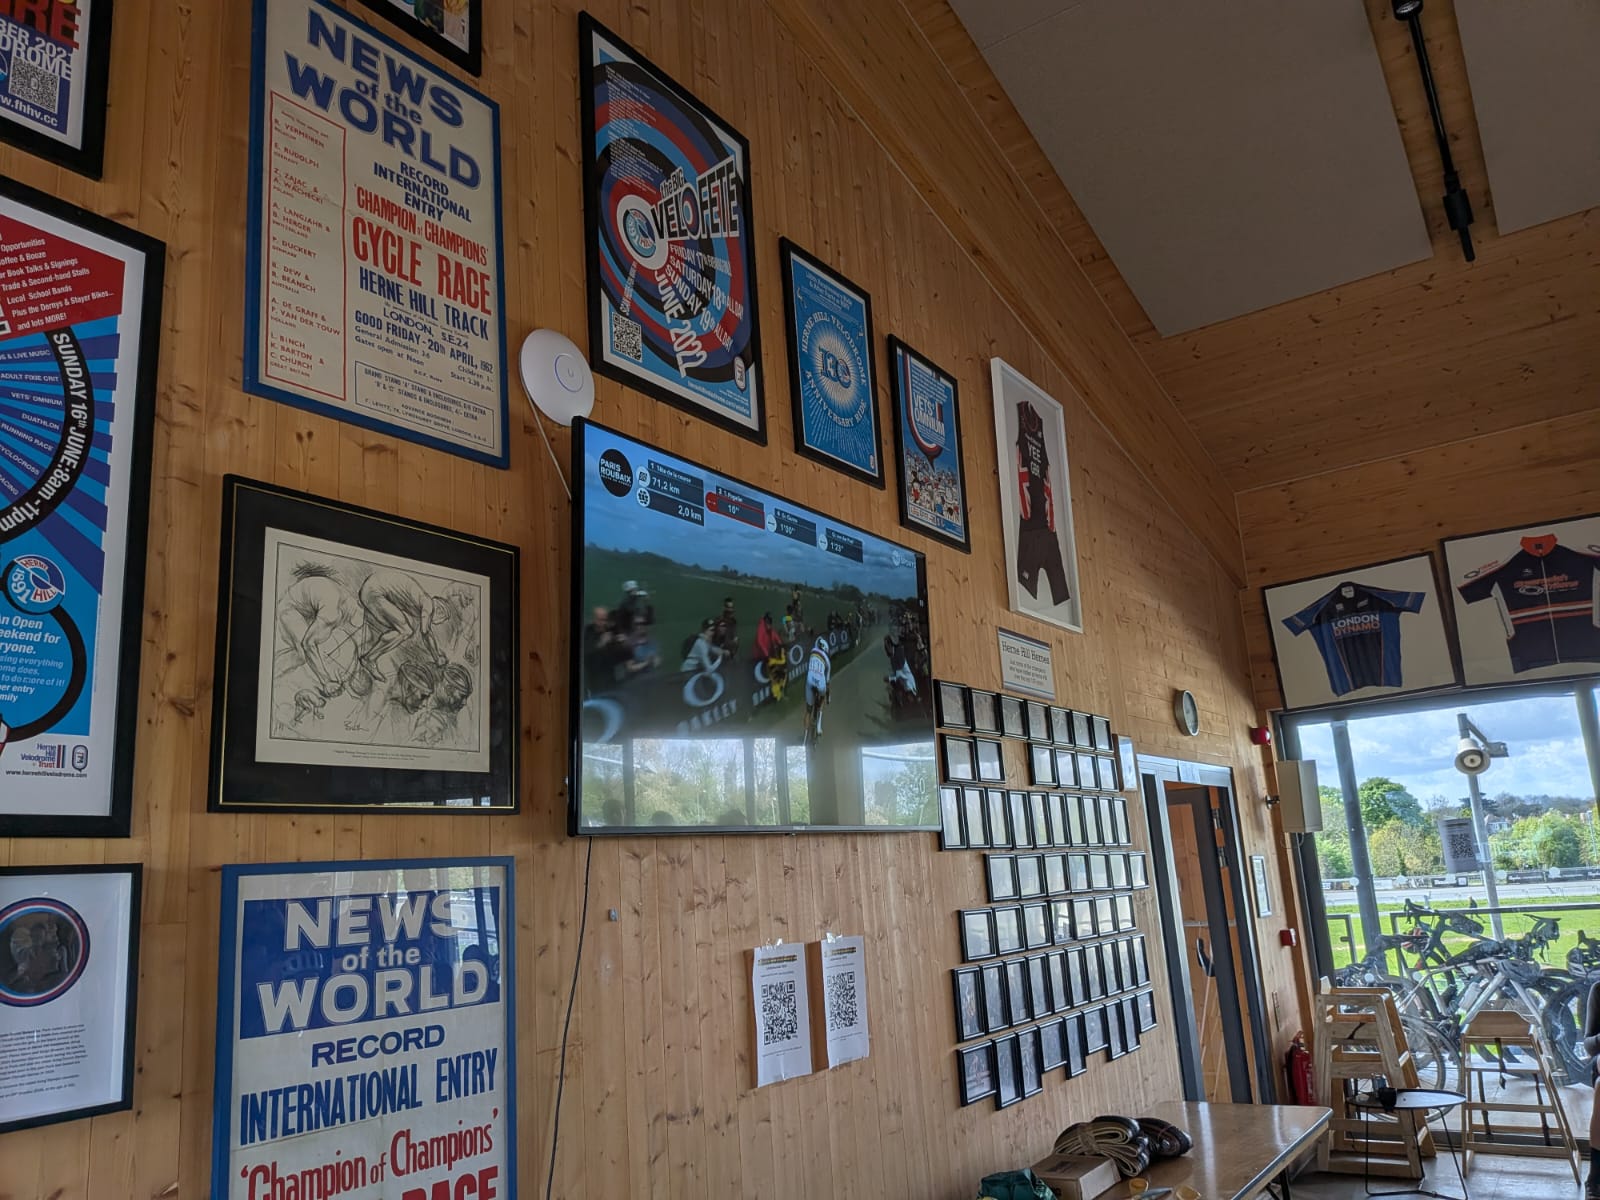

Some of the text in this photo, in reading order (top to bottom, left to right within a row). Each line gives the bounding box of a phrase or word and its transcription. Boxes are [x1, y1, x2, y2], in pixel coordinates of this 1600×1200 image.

[308, 7, 464, 128] NEWS
[0, 94, 58, 127] w.fhhv.cc
[355, 79, 423, 126] of the
[284, 50, 481, 190] WORLD
[400, 161, 449, 196] RECORD
[374, 162, 472, 223] INTERNATIONAL
[404, 191, 444, 223] ENTRY
[1, 238, 46, 252] Opportunities
[19, 251, 47, 262] & Booze
[669, 243, 696, 266] FRIDAY
[7, 257, 79, 278] Book Talks & Signings
[352, 216, 492, 316] CYCLE RACE
[670, 255, 712, 300] SATURDAY
[2, 267, 90, 292] Trade & Second-hand Stalls
[665, 264, 702, 316] SUNDAY
[7, 283, 73, 305] Local School Bands
[12, 308, 28, 318] Plus
[28, 305, 40, 314] the
[64, 297, 71, 306] &
[70, 294, 91, 306] Stayer
[360, 266, 404, 306] HERNE
[409, 288, 439, 321] HILL
[443, 303, 489, 342] TRACK
[654, 270, 685, 324] JUNE
[17, 312, 67, 331] and lots MORE!
[355, 310, 383, 330] GOOD
[386, 321, 421, 345] FRIDAY
[355, 325, 419, 355] General Admission
[355, 335, 375, 349] Gates
[377, 345, 394, 357] open
[670, 319, 708, 379] 2022
[801, 315, 815, 353] HERNE
[813, 311, 830, 322] HILL
[831, 315, 867, 387] VELODROME
[53, 332, 88, 401] SUNDAY
[450, 371, 467, 383] Start
[1, 422, 34, 443] RUNNING
[21, 412, 61, 431] DUATHLON
[600, 458, 621, 472] PARIS
[600, 466, 631, 484] ROUBAIX
[652, 476, 680, 495] 71,2 km
[678, 504, 702, 521] 2,0 km
[12, 615, 43, 630] Open
[1331, 613, 1380, 629] LONDON
[1333, 622, 1381, 638] DYNAMO
[43, 632, 62, 645] for
[18, 656, 64, 670] everything
[1, 673, 10, 682] to
[11, 674, 23, 683] do
[45, 678, 56, 687] of
[12, 684, 36, 695] entry
[284, 891, 468, 952] NEWS
[342, 944, 420, 972] of the
[256, 959, 489, 1035] WORLD
[311, 1024, 446, 1068] RECORD
[240, 1048, 498, 1146] INTERNATIONAL ENTRY
[370, 1152, 386, 1185] of
